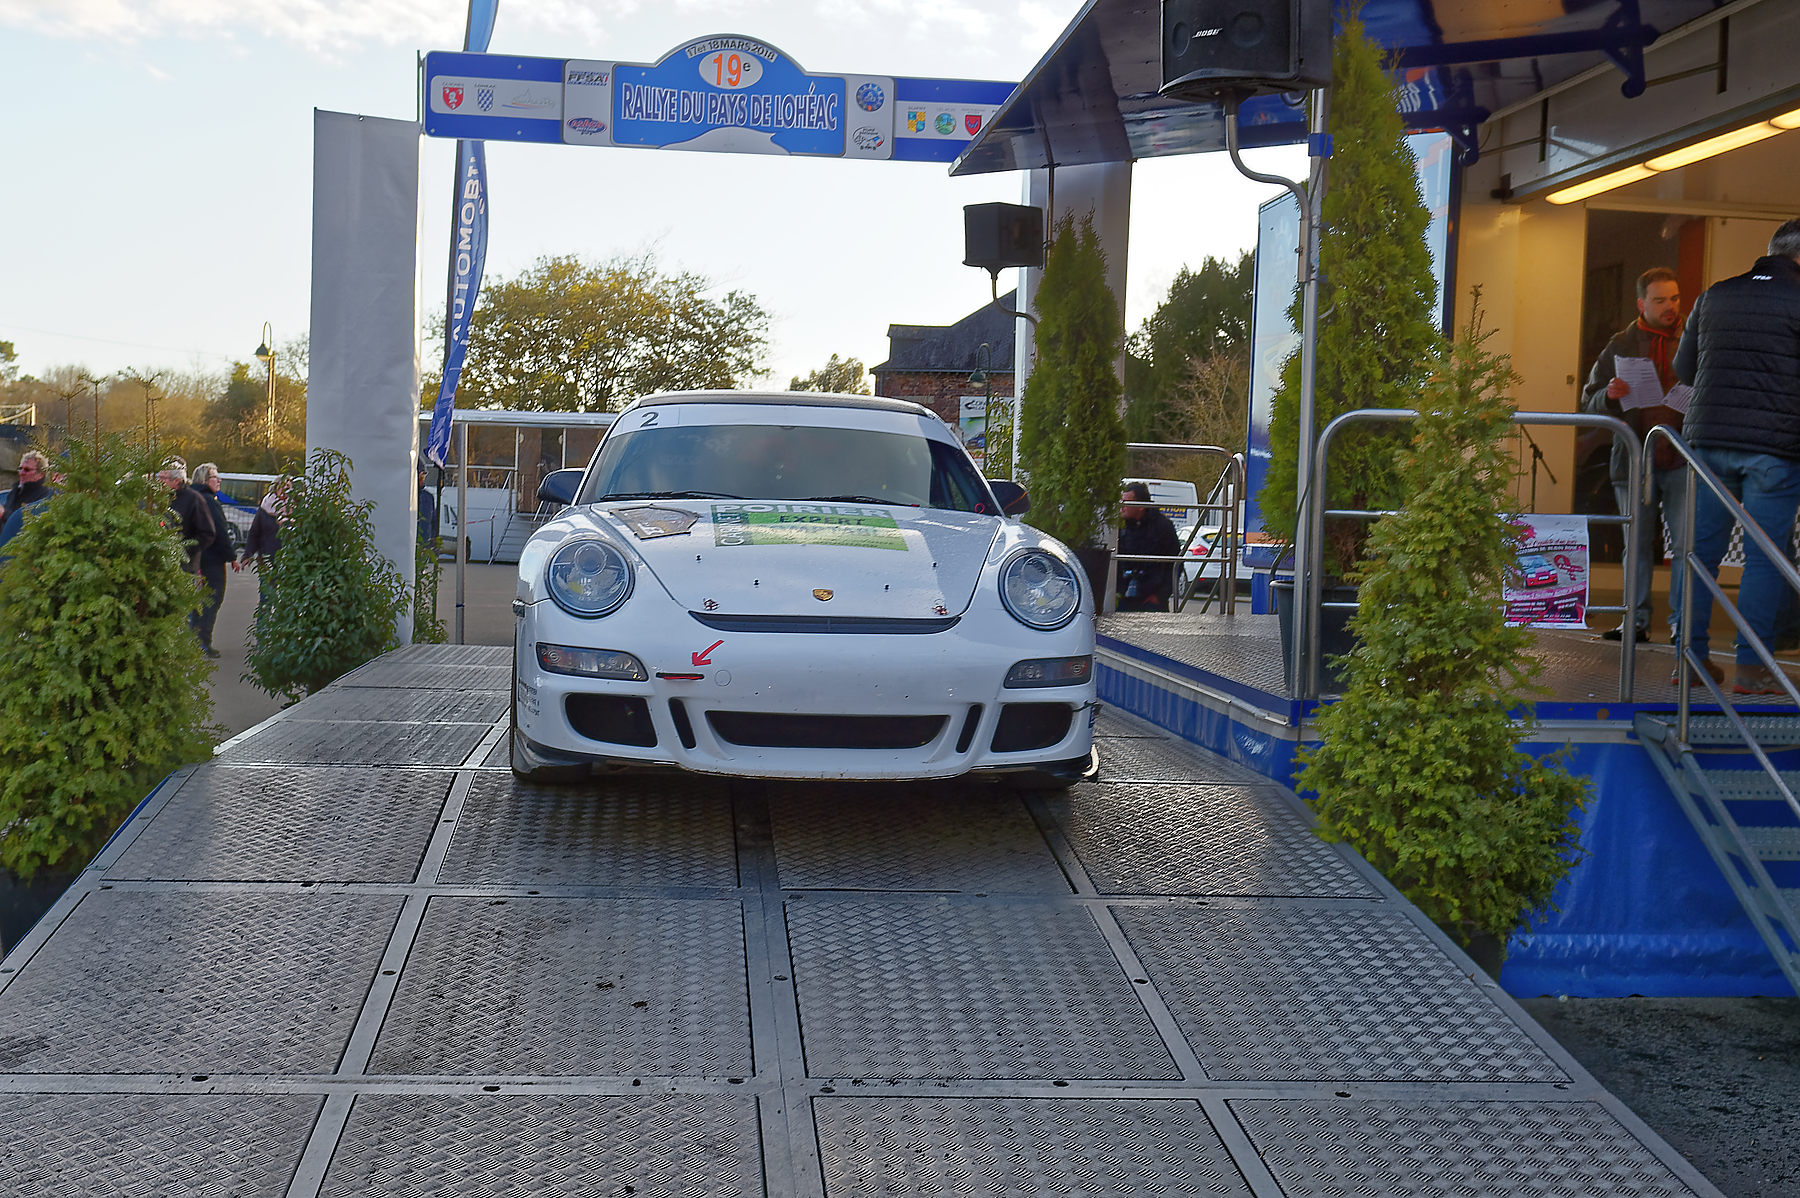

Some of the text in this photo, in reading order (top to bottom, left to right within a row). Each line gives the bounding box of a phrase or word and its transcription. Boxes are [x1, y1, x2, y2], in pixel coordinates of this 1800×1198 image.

[621, 81, 838, 131] RALLYE DU PAYS DE LOHÉAC
[640, 411, 660, 428] 2
[715, 504, 891, 518] POIRIER
[779, 515, 866, 526] EXPERT
